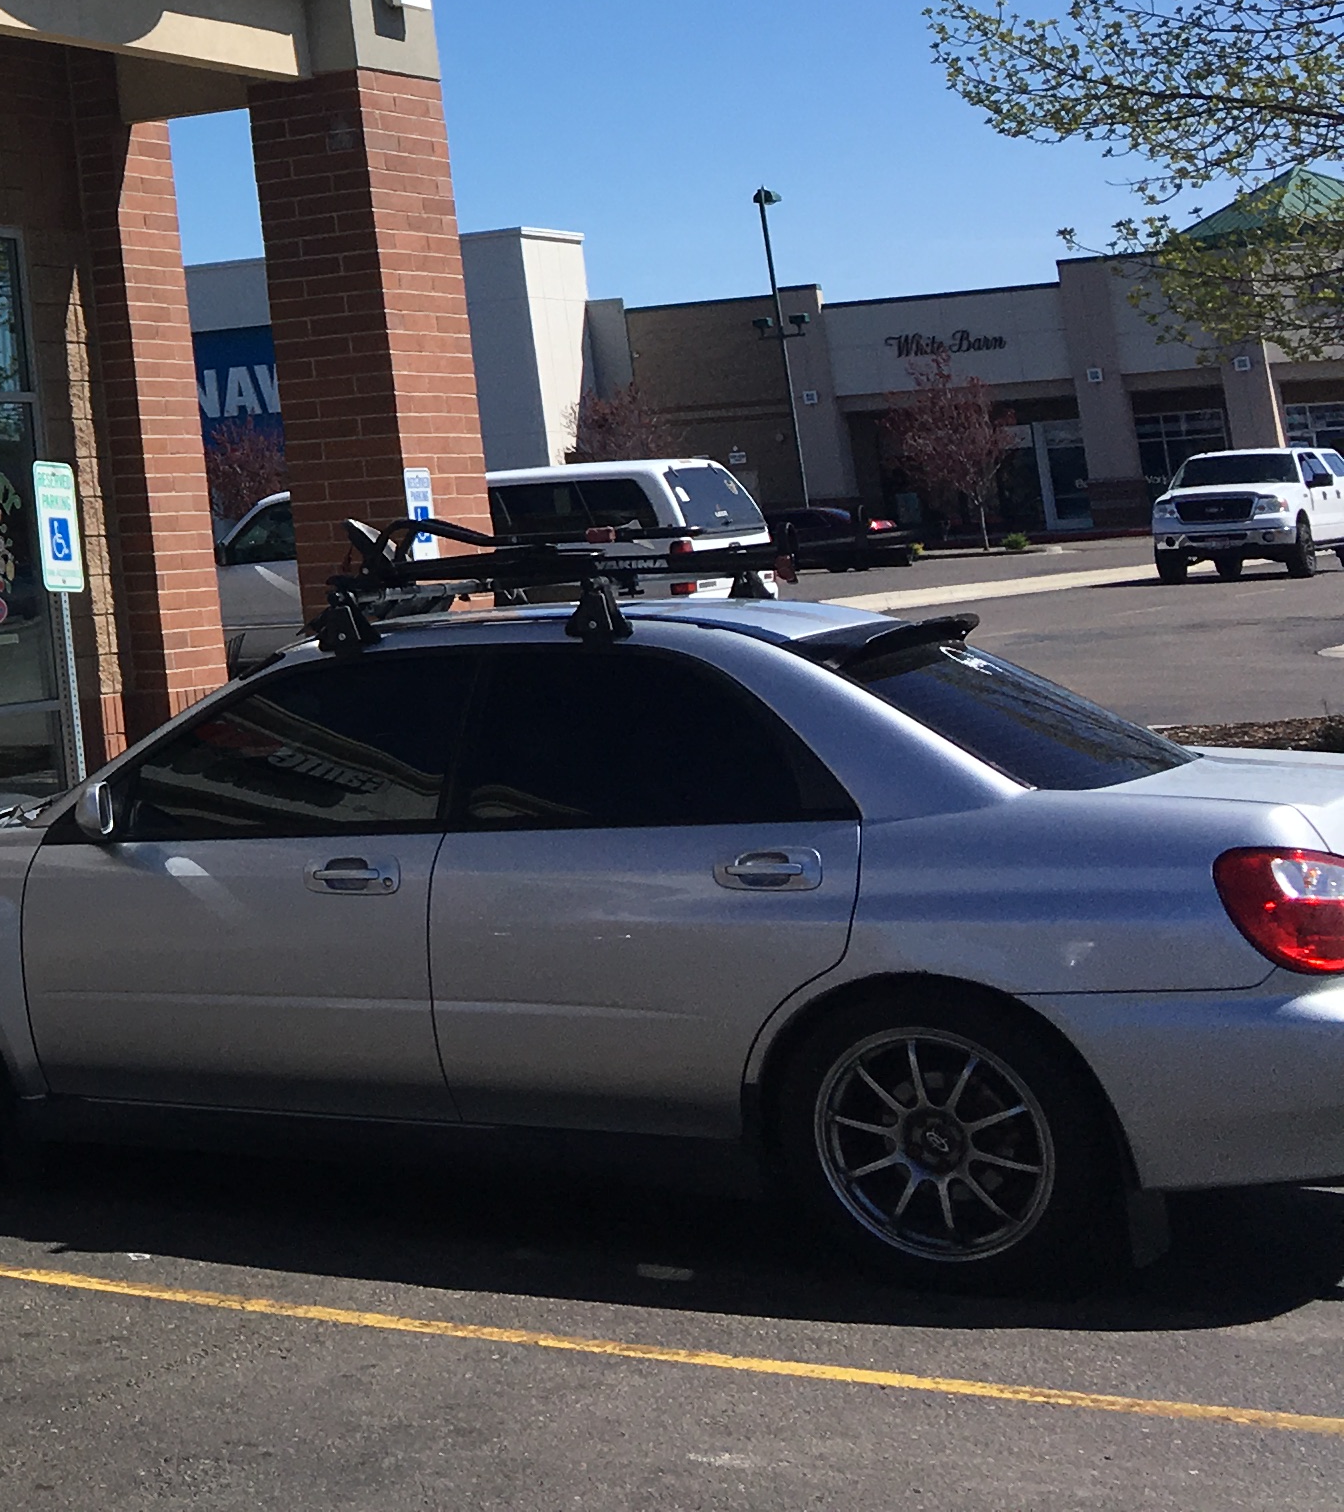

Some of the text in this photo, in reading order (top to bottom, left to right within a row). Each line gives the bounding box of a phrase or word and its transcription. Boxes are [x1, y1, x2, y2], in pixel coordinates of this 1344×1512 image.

[884, 329, 1007, 359] White Barn
[594, 558, 669, 570] YAKIMA
